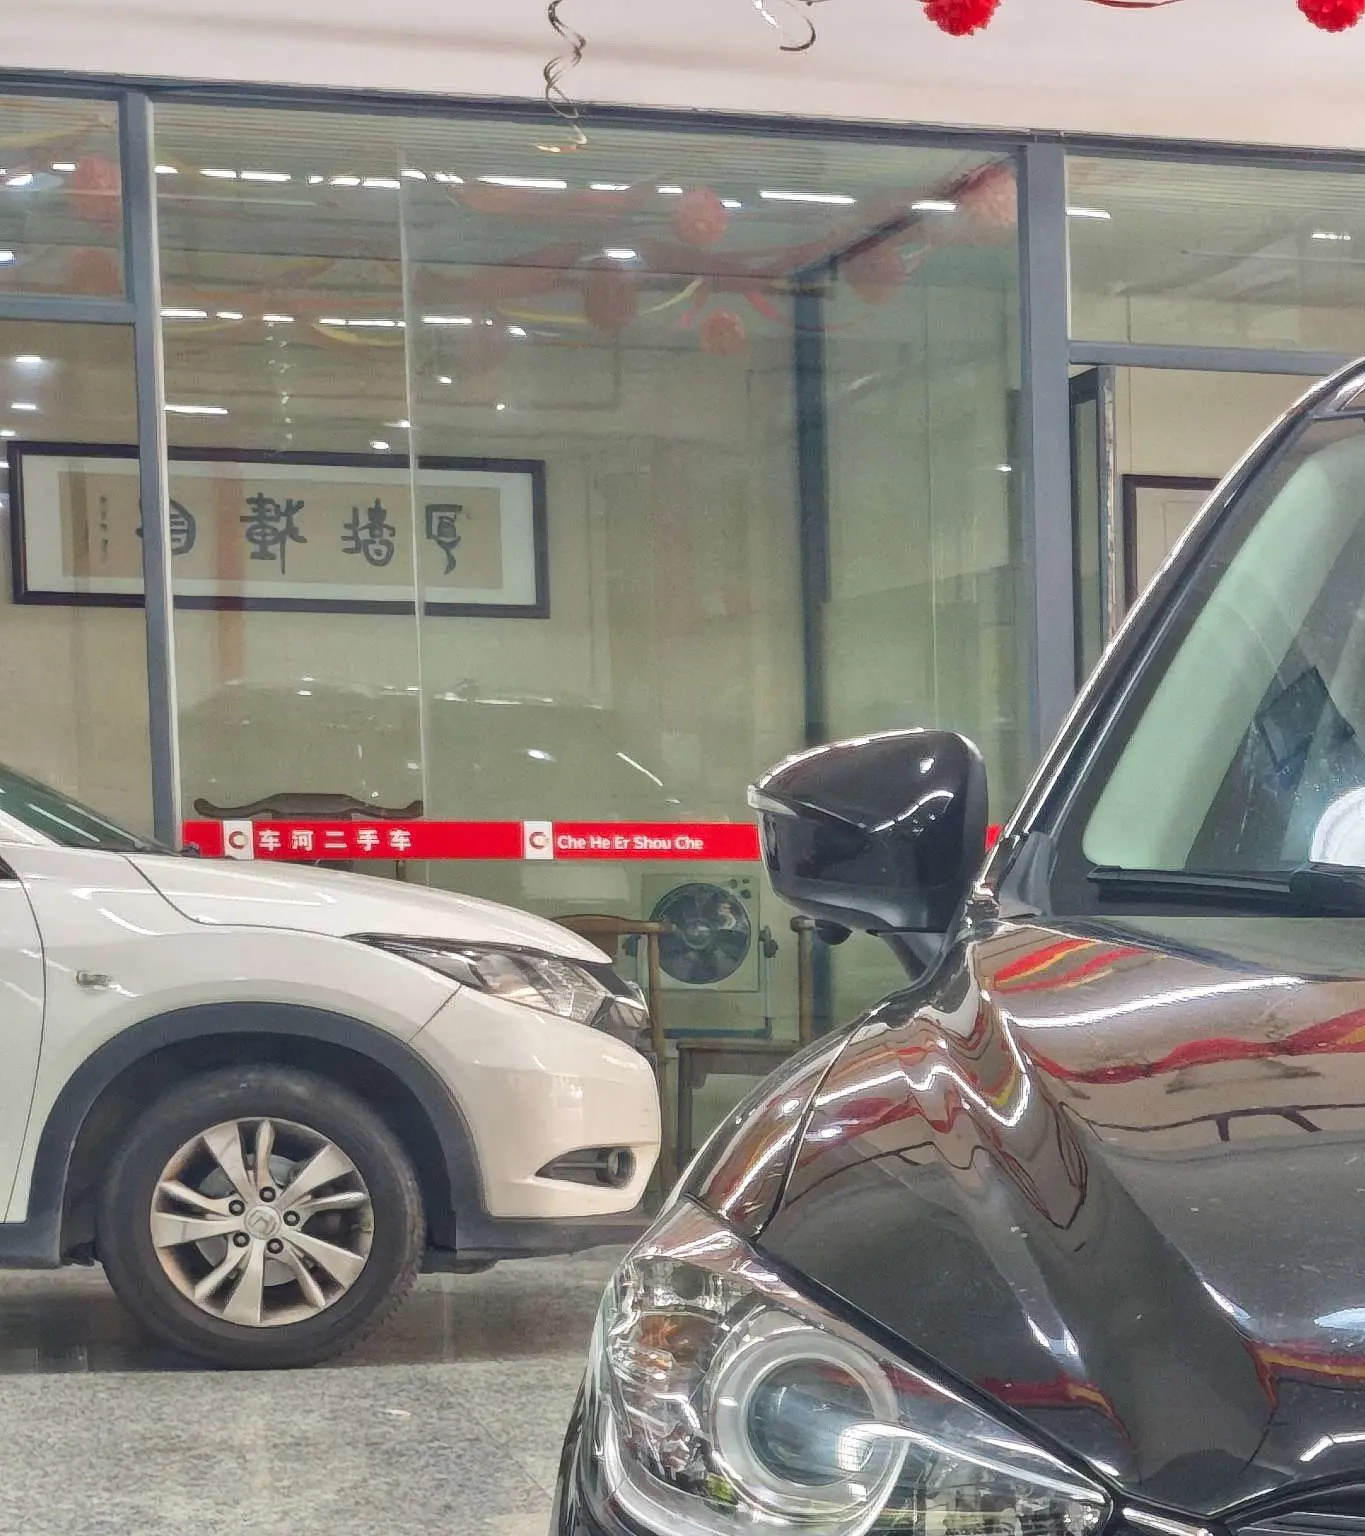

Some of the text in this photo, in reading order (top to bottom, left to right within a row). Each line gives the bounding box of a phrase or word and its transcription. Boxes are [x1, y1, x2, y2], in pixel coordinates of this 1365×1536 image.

[258, 829, 413, 851] 车河二手车
[557, 835, 587, 850] Che
[590, 836, 610, 850] He
[614, 836, 630, 850] Er
[633, 836, 671, 850] Shou
[675, 835, 704, 850] Che
